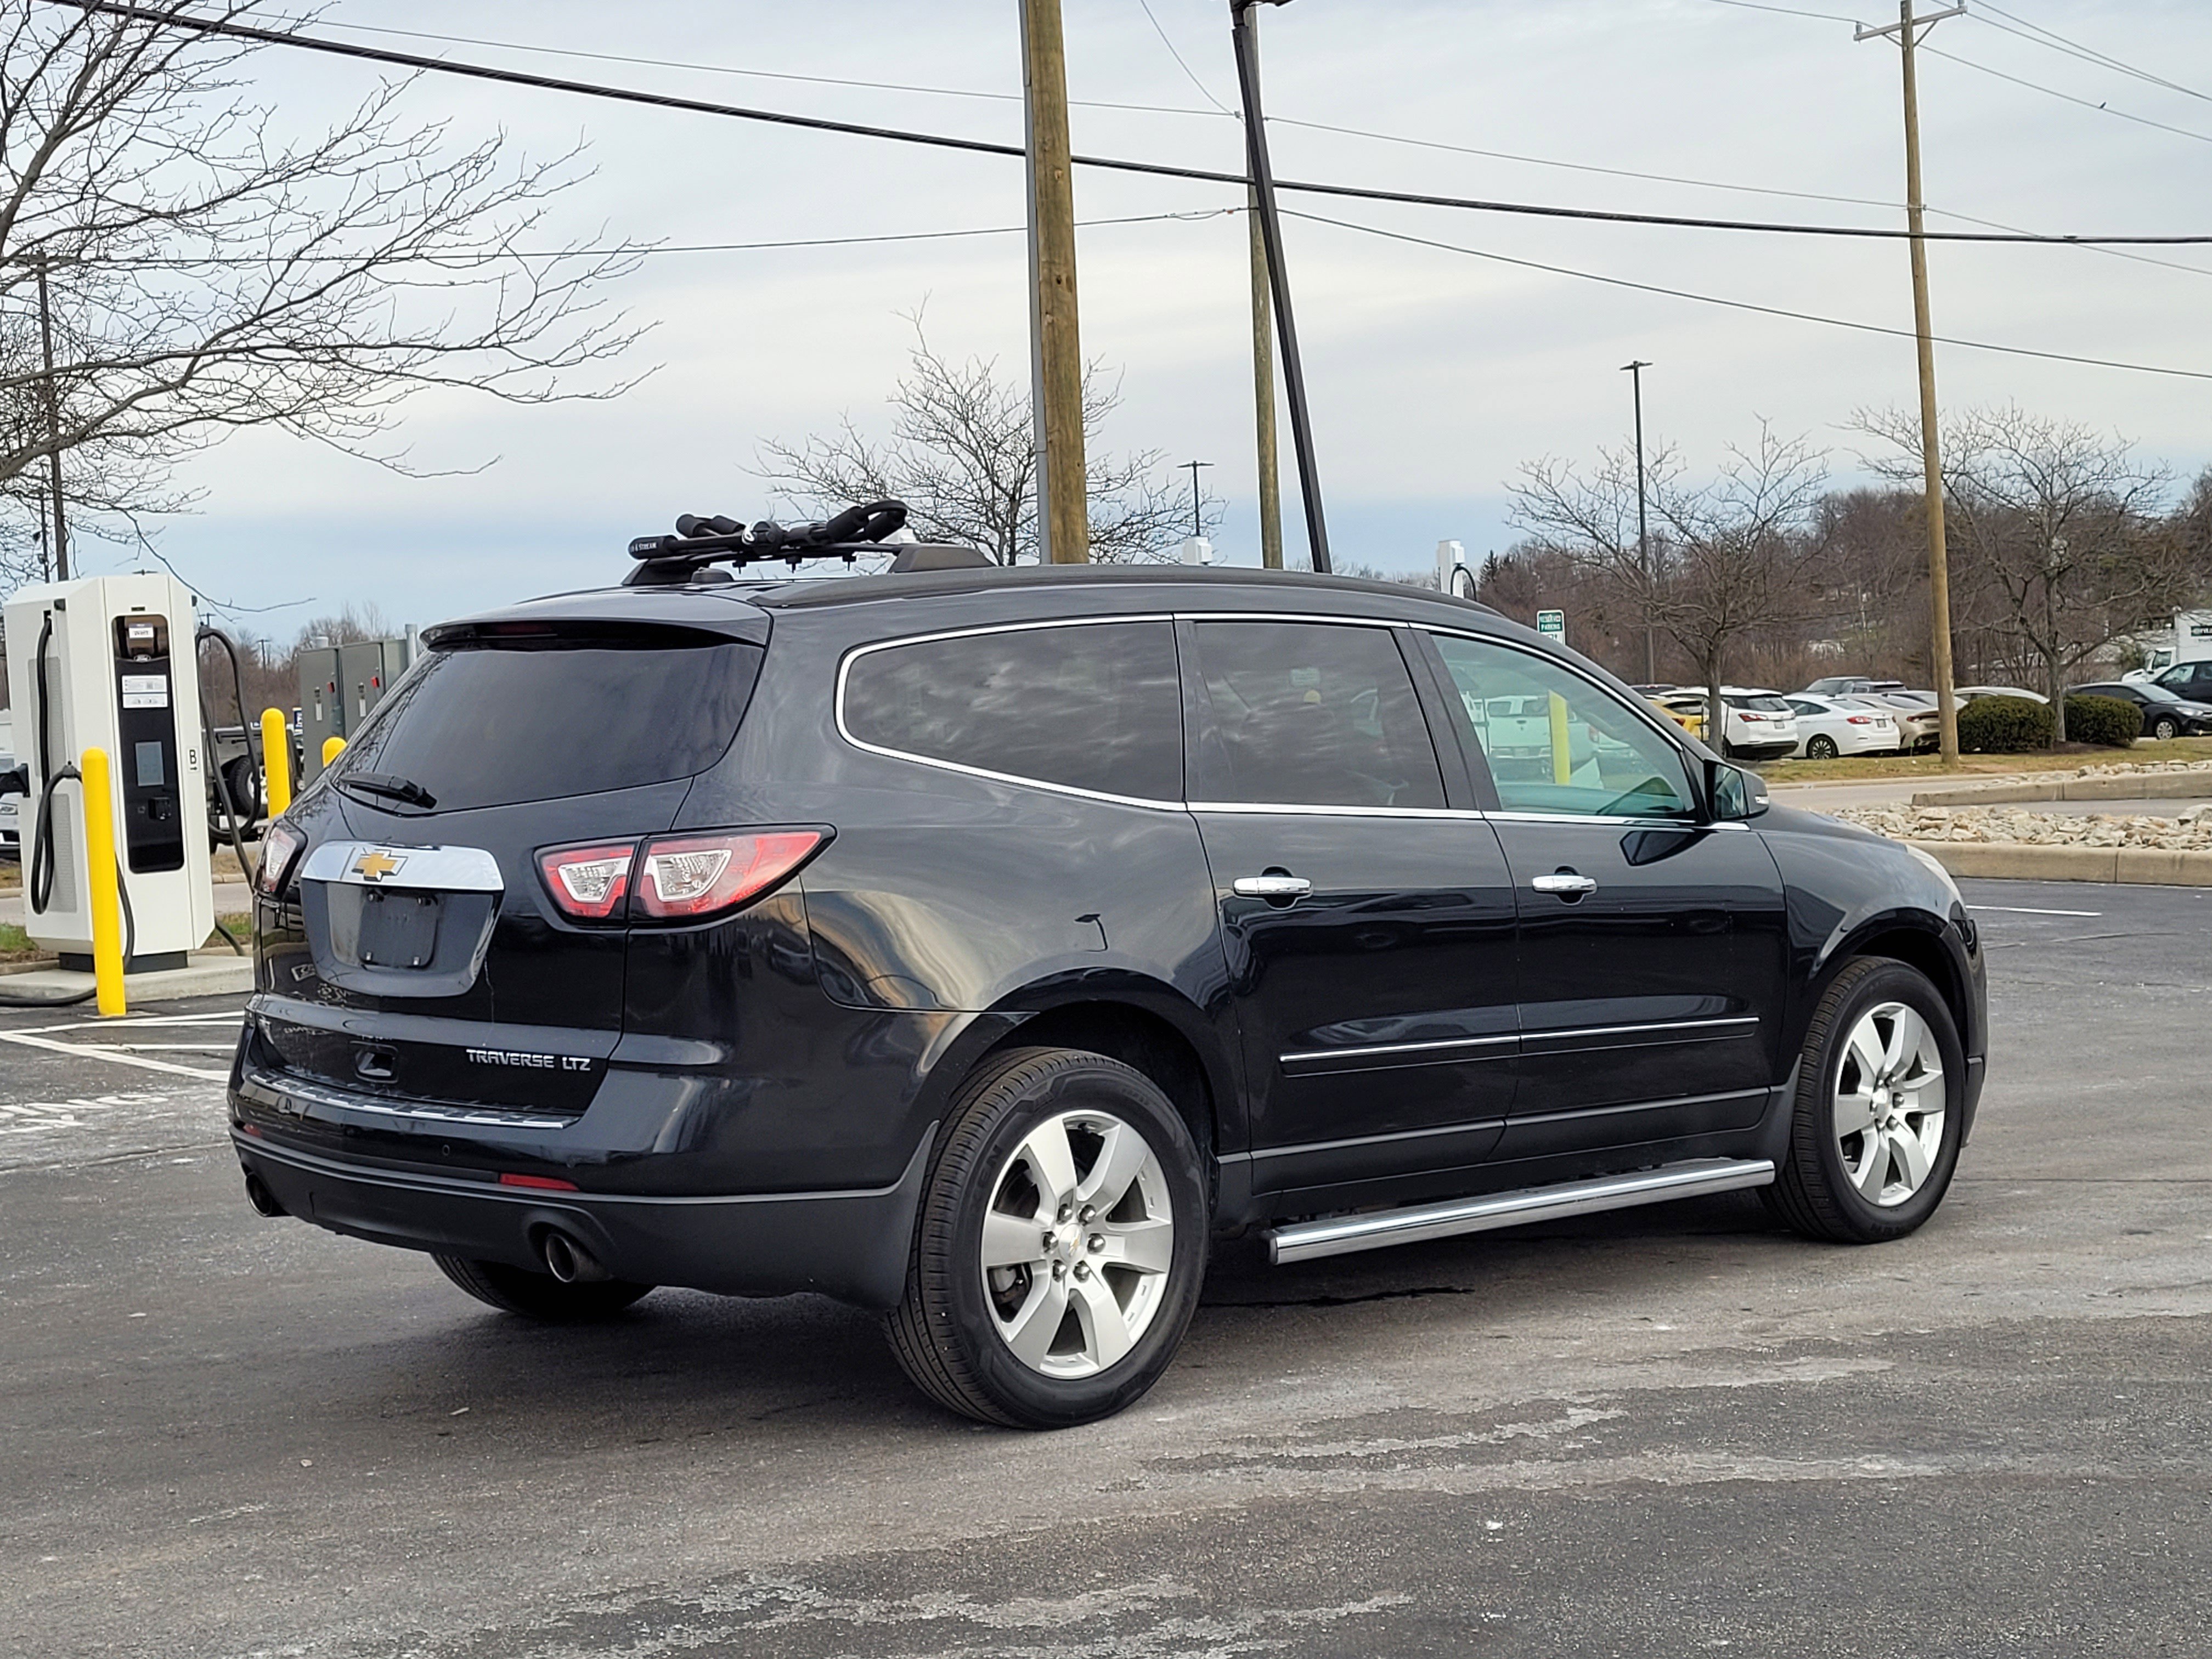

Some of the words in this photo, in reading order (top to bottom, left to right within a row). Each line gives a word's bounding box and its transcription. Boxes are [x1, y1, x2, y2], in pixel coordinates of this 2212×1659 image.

[189, 749, 196, 764] B
[466, 1048, 555, 1068] TRAVERSE
[562, 1056, 591, 1070] LTZ
